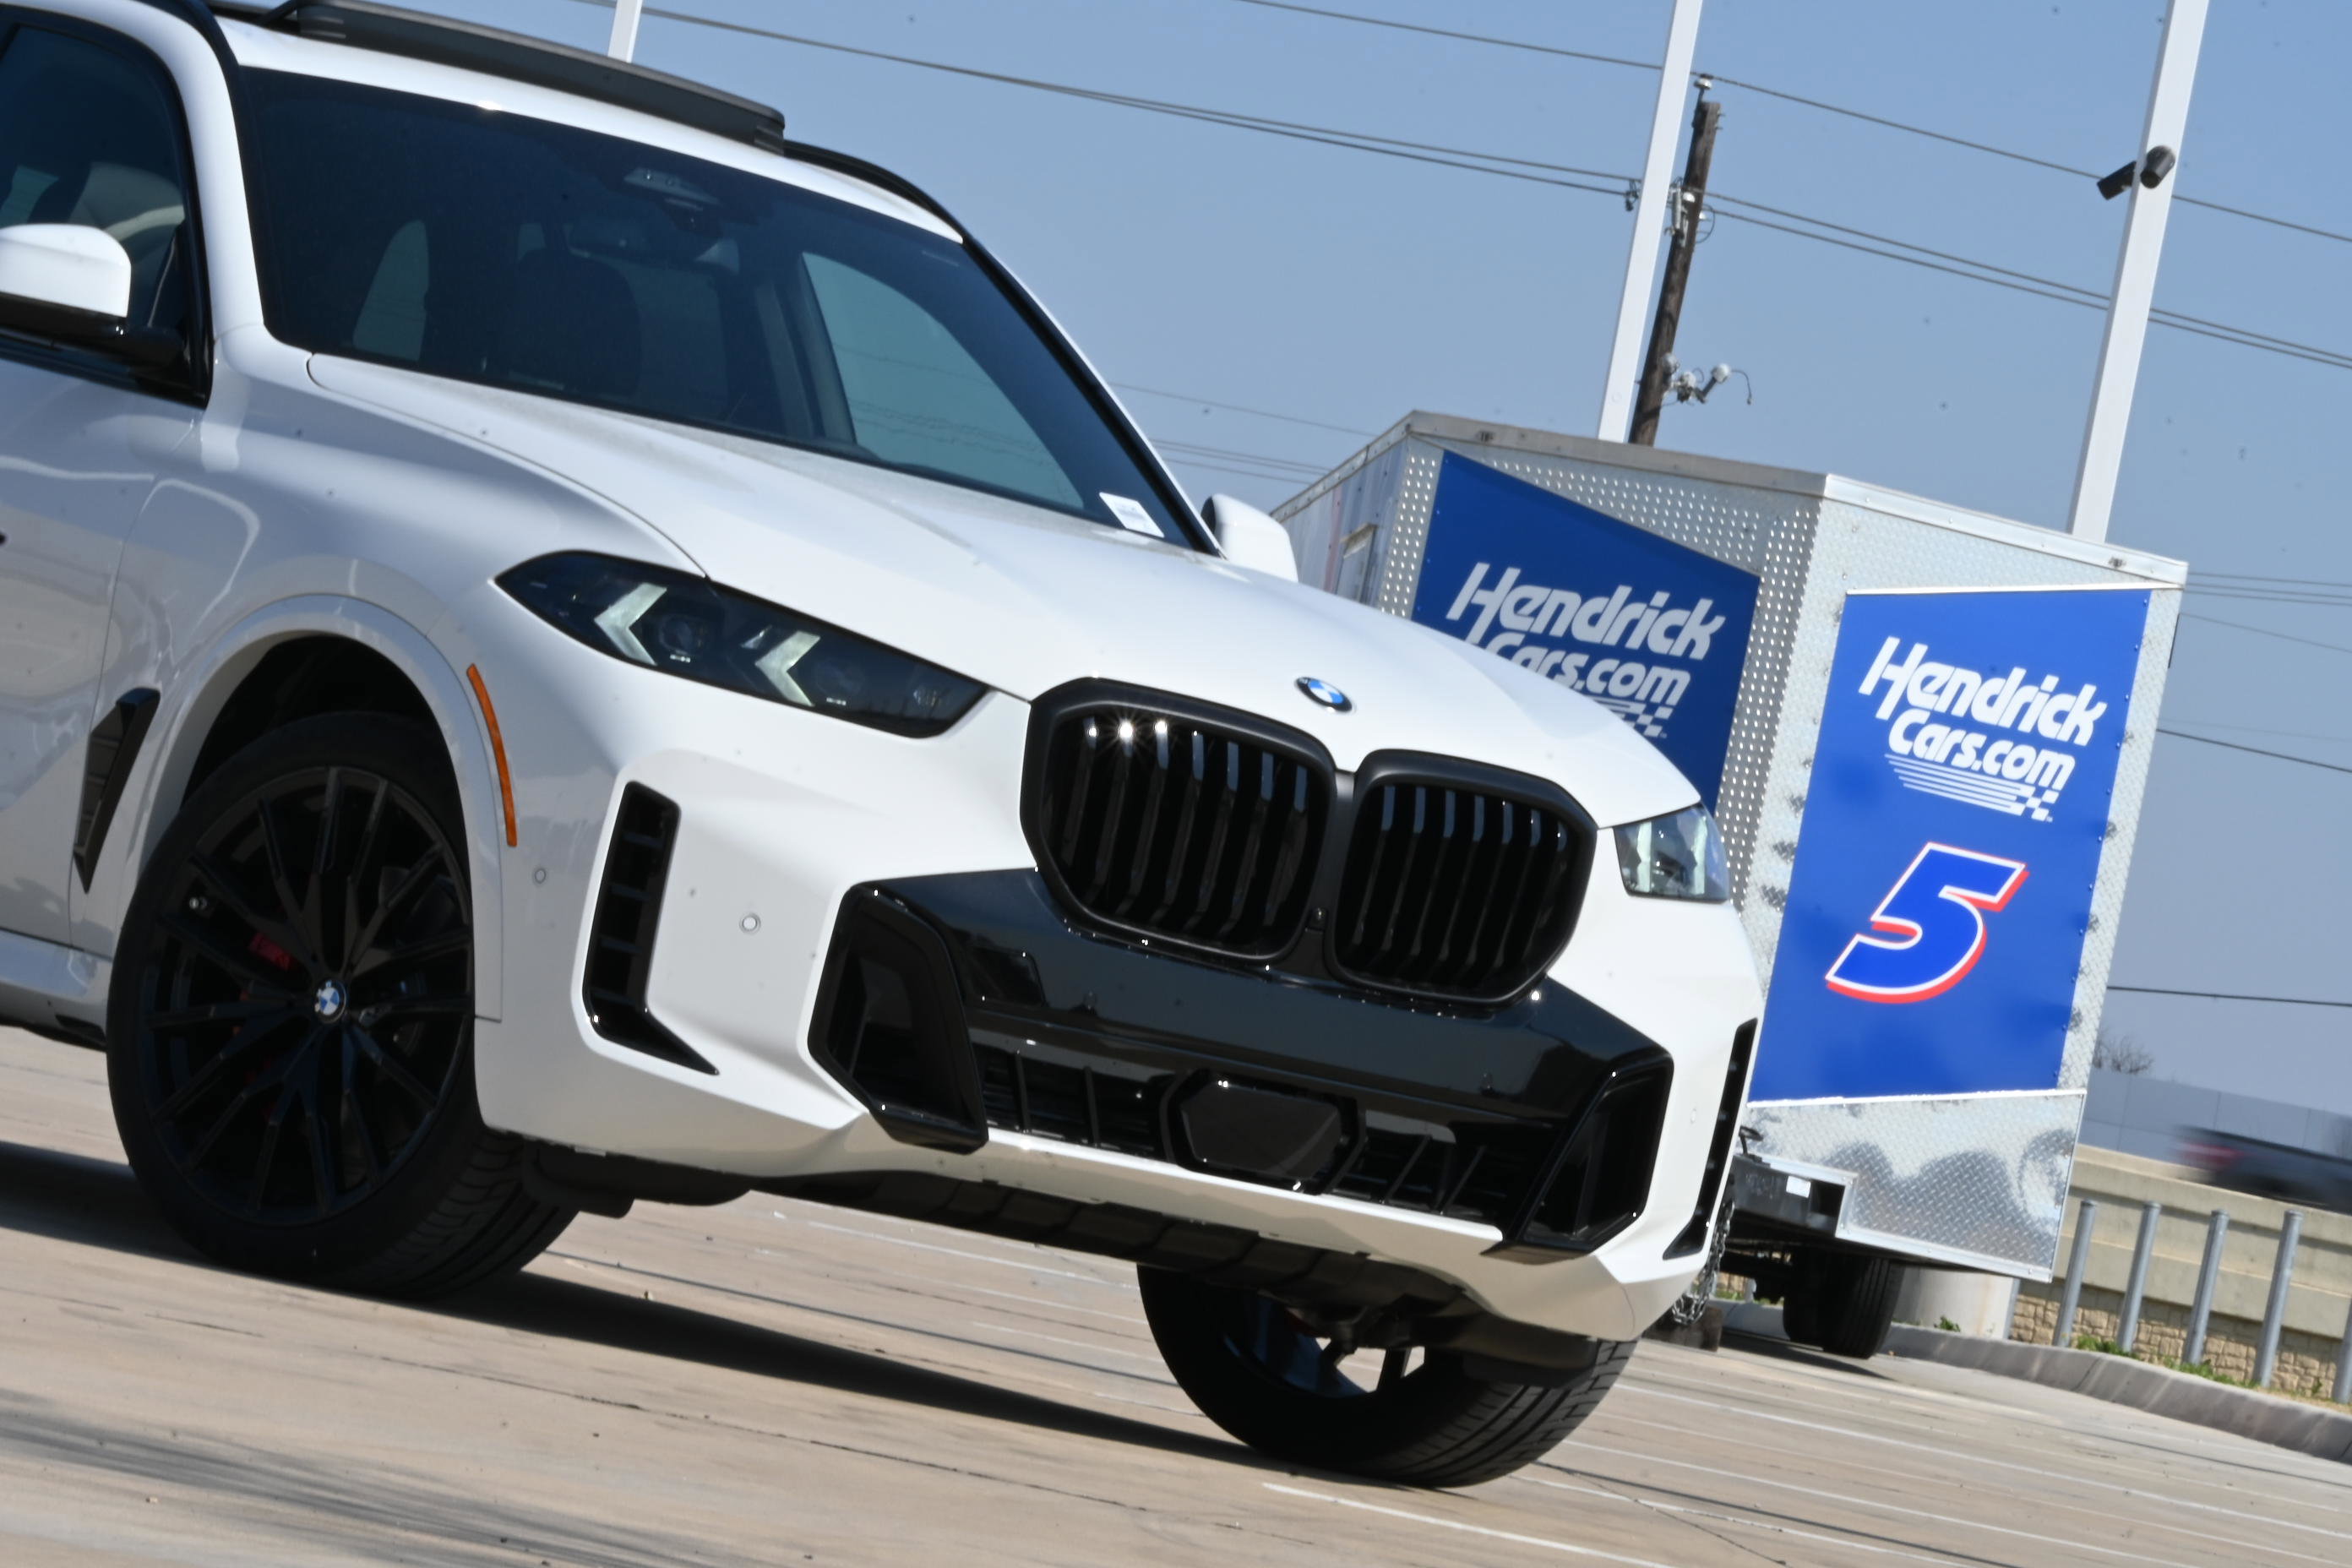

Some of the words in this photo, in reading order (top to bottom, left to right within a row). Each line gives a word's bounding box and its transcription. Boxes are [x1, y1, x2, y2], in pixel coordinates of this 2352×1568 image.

[1446, 562, 1726, 661] Hendrick
[1859, 635, 2107, 746] Hendrick
[1888, 708, 2076, 791] Cars.com
[1825, 841, 2029, 1004] 5
